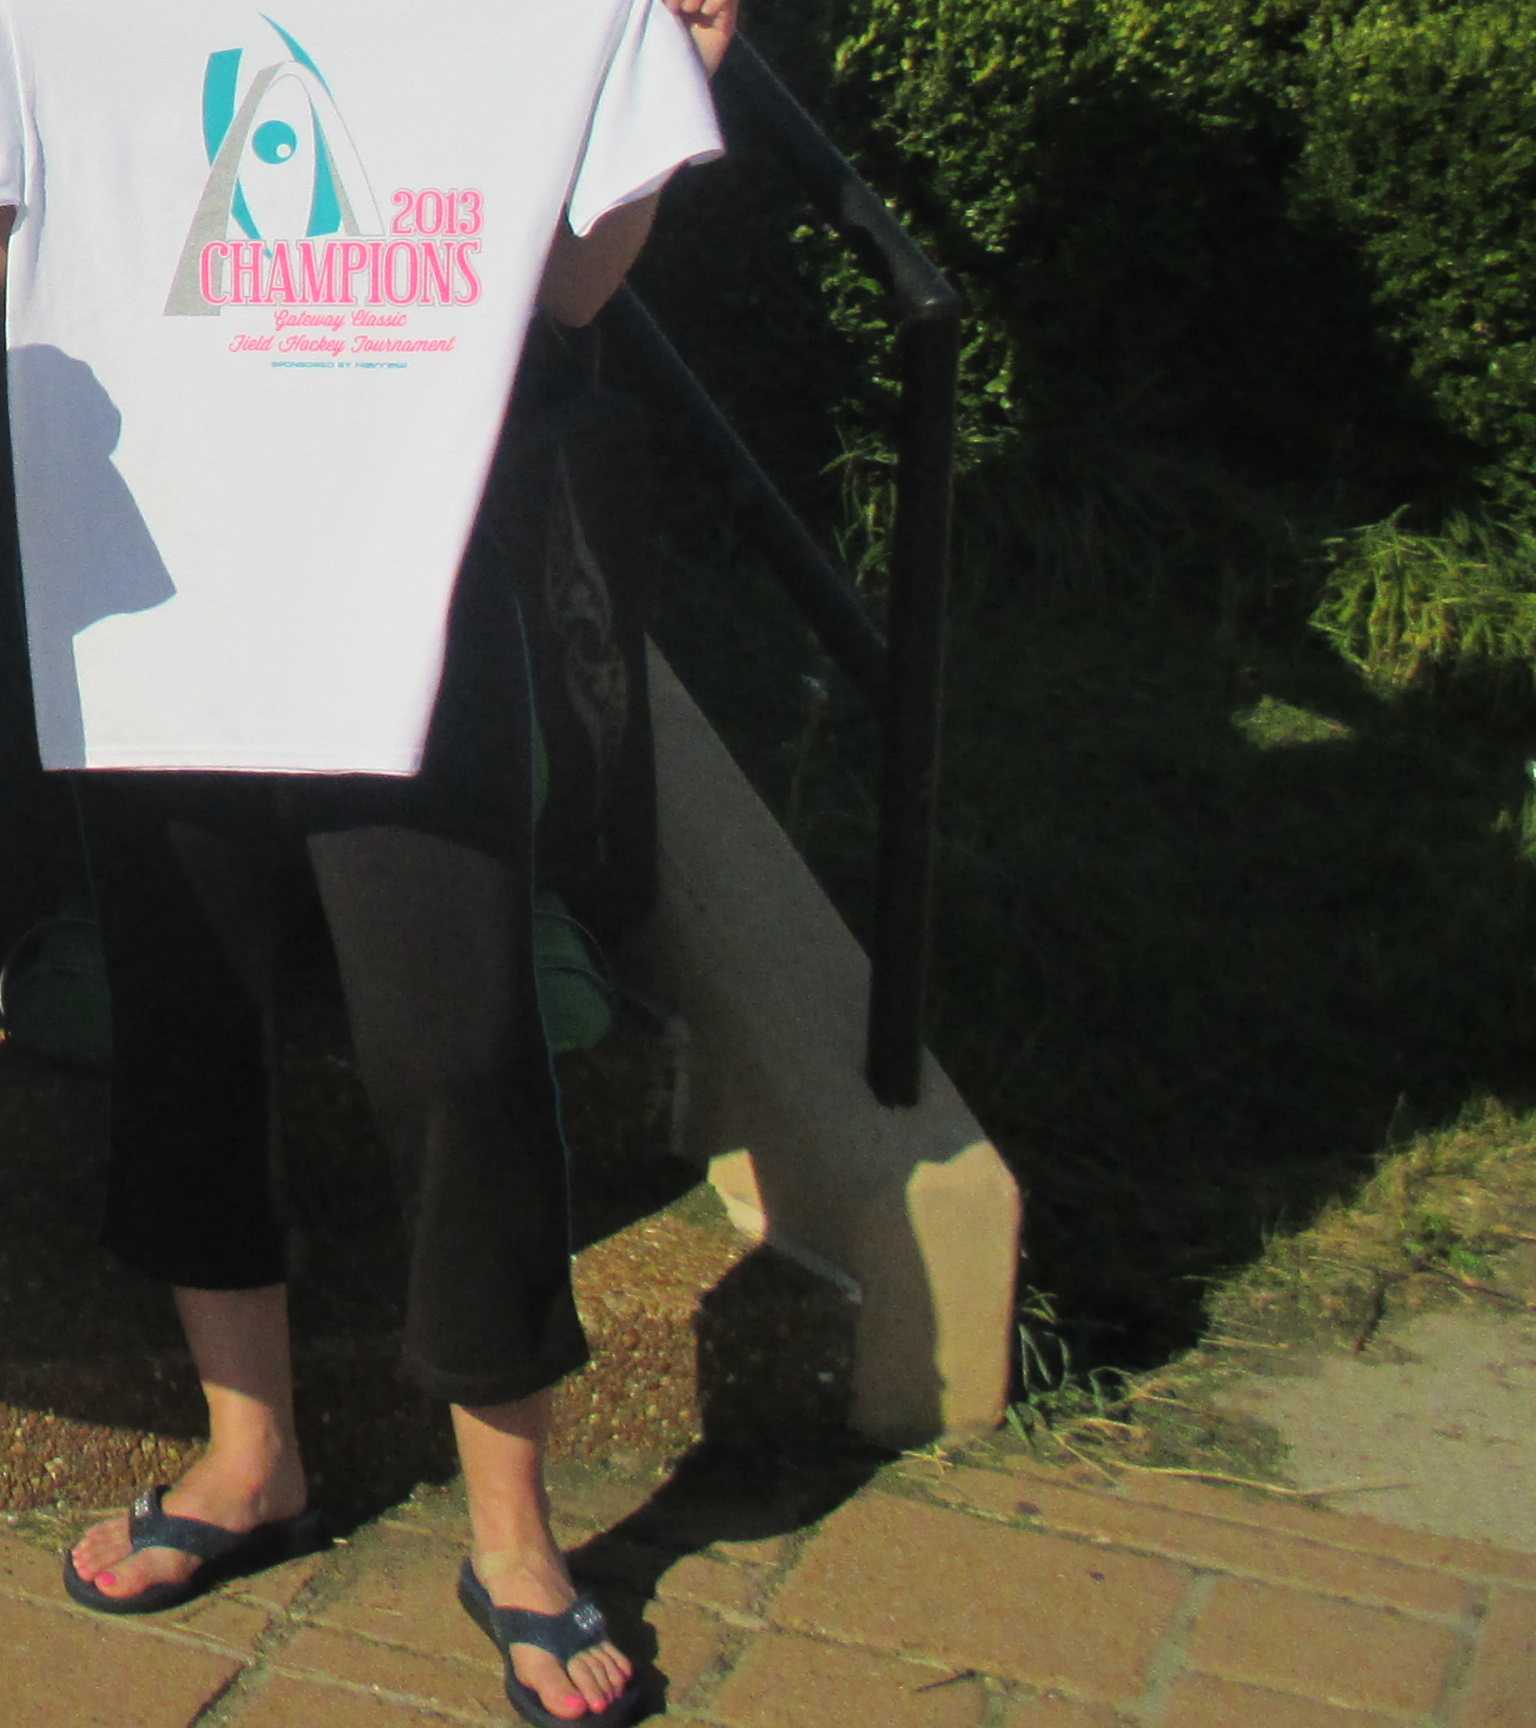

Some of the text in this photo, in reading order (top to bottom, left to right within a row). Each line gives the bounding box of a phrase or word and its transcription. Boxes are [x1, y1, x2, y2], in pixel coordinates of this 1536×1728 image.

[390, 189, 484, 235] 2013
[200, 239, 483, 307] CHAMPIONS
[273, 309, 409, 331] Gateway Classic
[228, 334, 457, 357] Field Hockey Tournament
